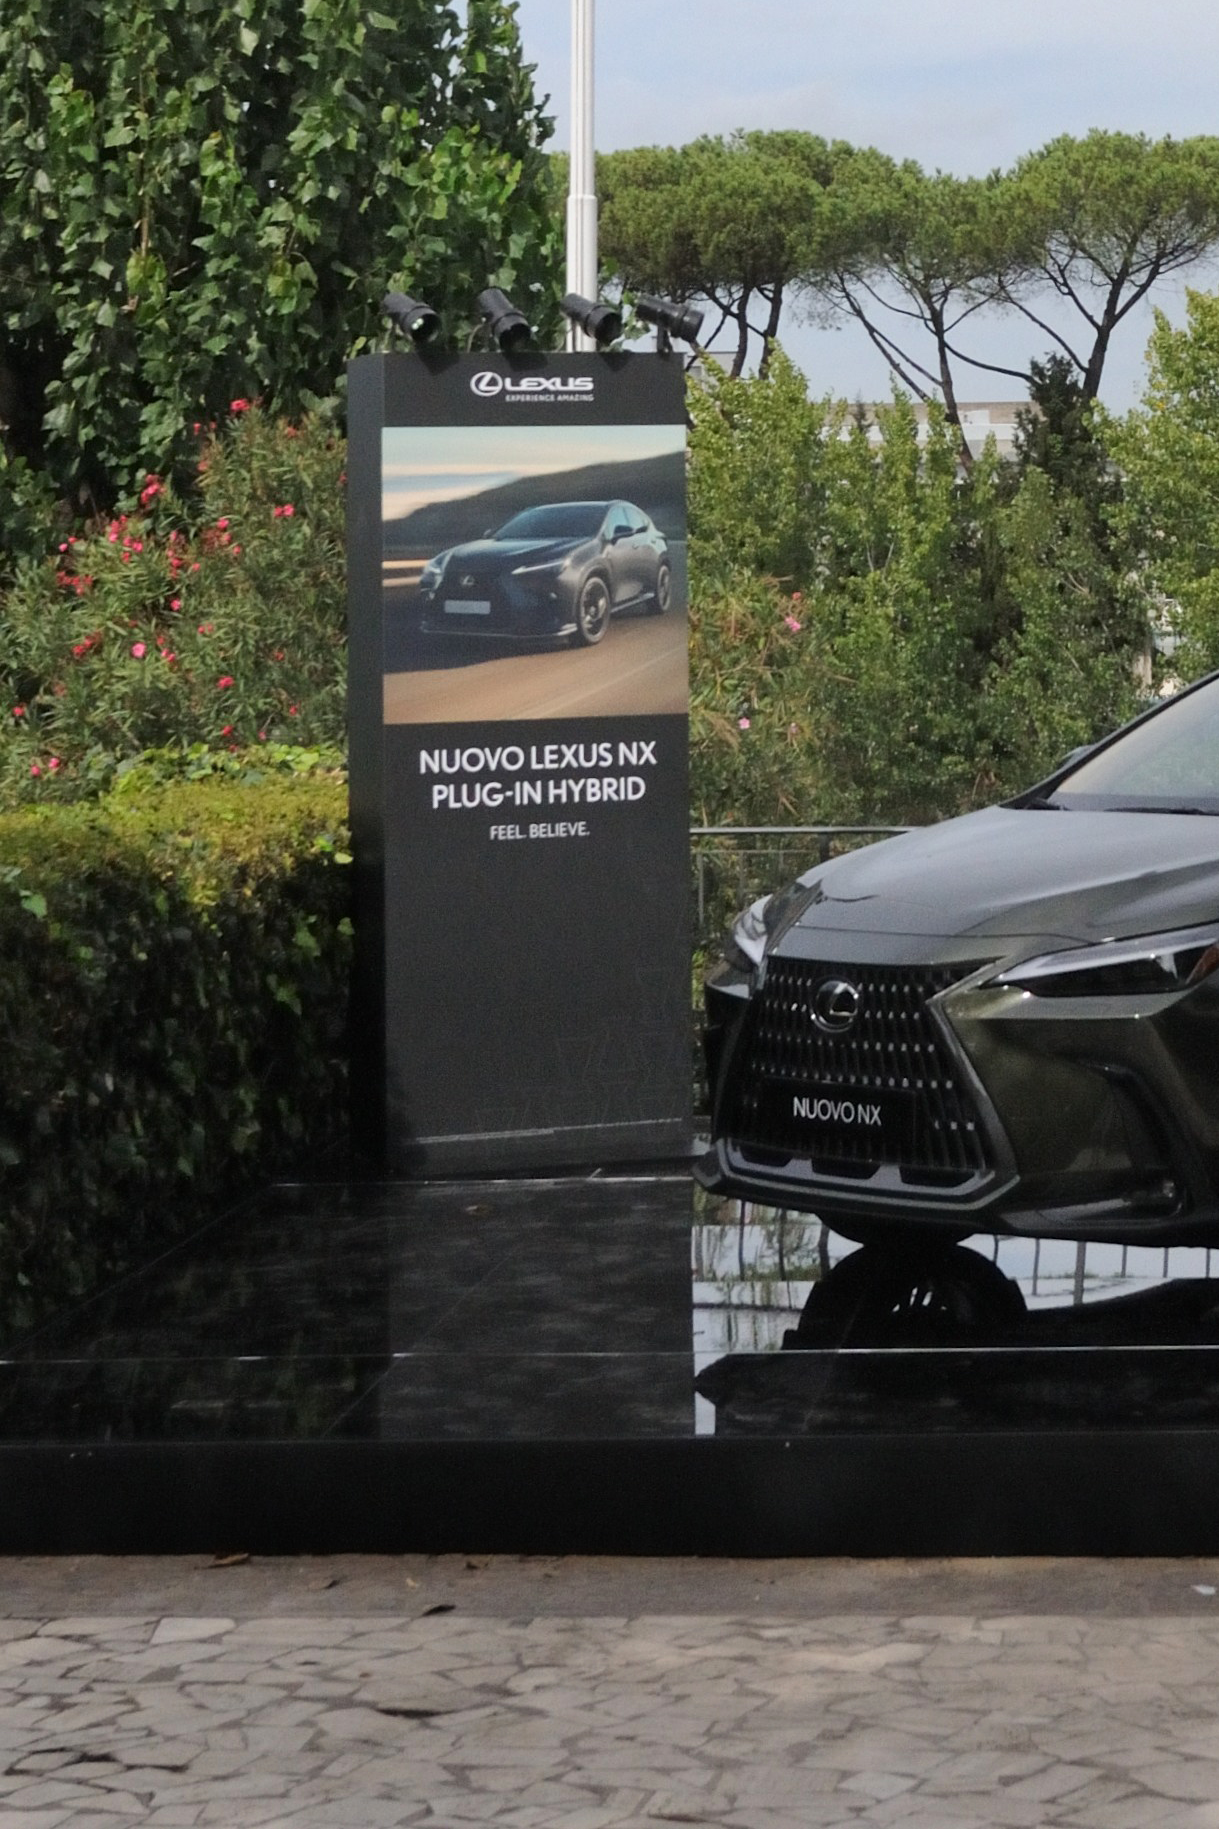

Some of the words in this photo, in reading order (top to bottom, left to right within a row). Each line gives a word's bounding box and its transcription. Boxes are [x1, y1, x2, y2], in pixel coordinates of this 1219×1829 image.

[504, 377, 594, 391] LEXUS
[505, 394, 555, 402] EXPERIENCE
[557, 394, 594, 402] AMAZING
[419, 746, 525, 774] NUOVO
[530, 742, 613, 770] LEXUS
[618, 741, 658, 766] NX
[432, 780, 543, 809] PLUG-IN
[548, 776, 646, 804] HYBRID
[490, 825, 527, 841] FEEL.
[529, 821, 590, 839] BELIEVE.
[793, 1095, 856, 1123] NUOVO
[857, 1103, 882, 1126] NX
